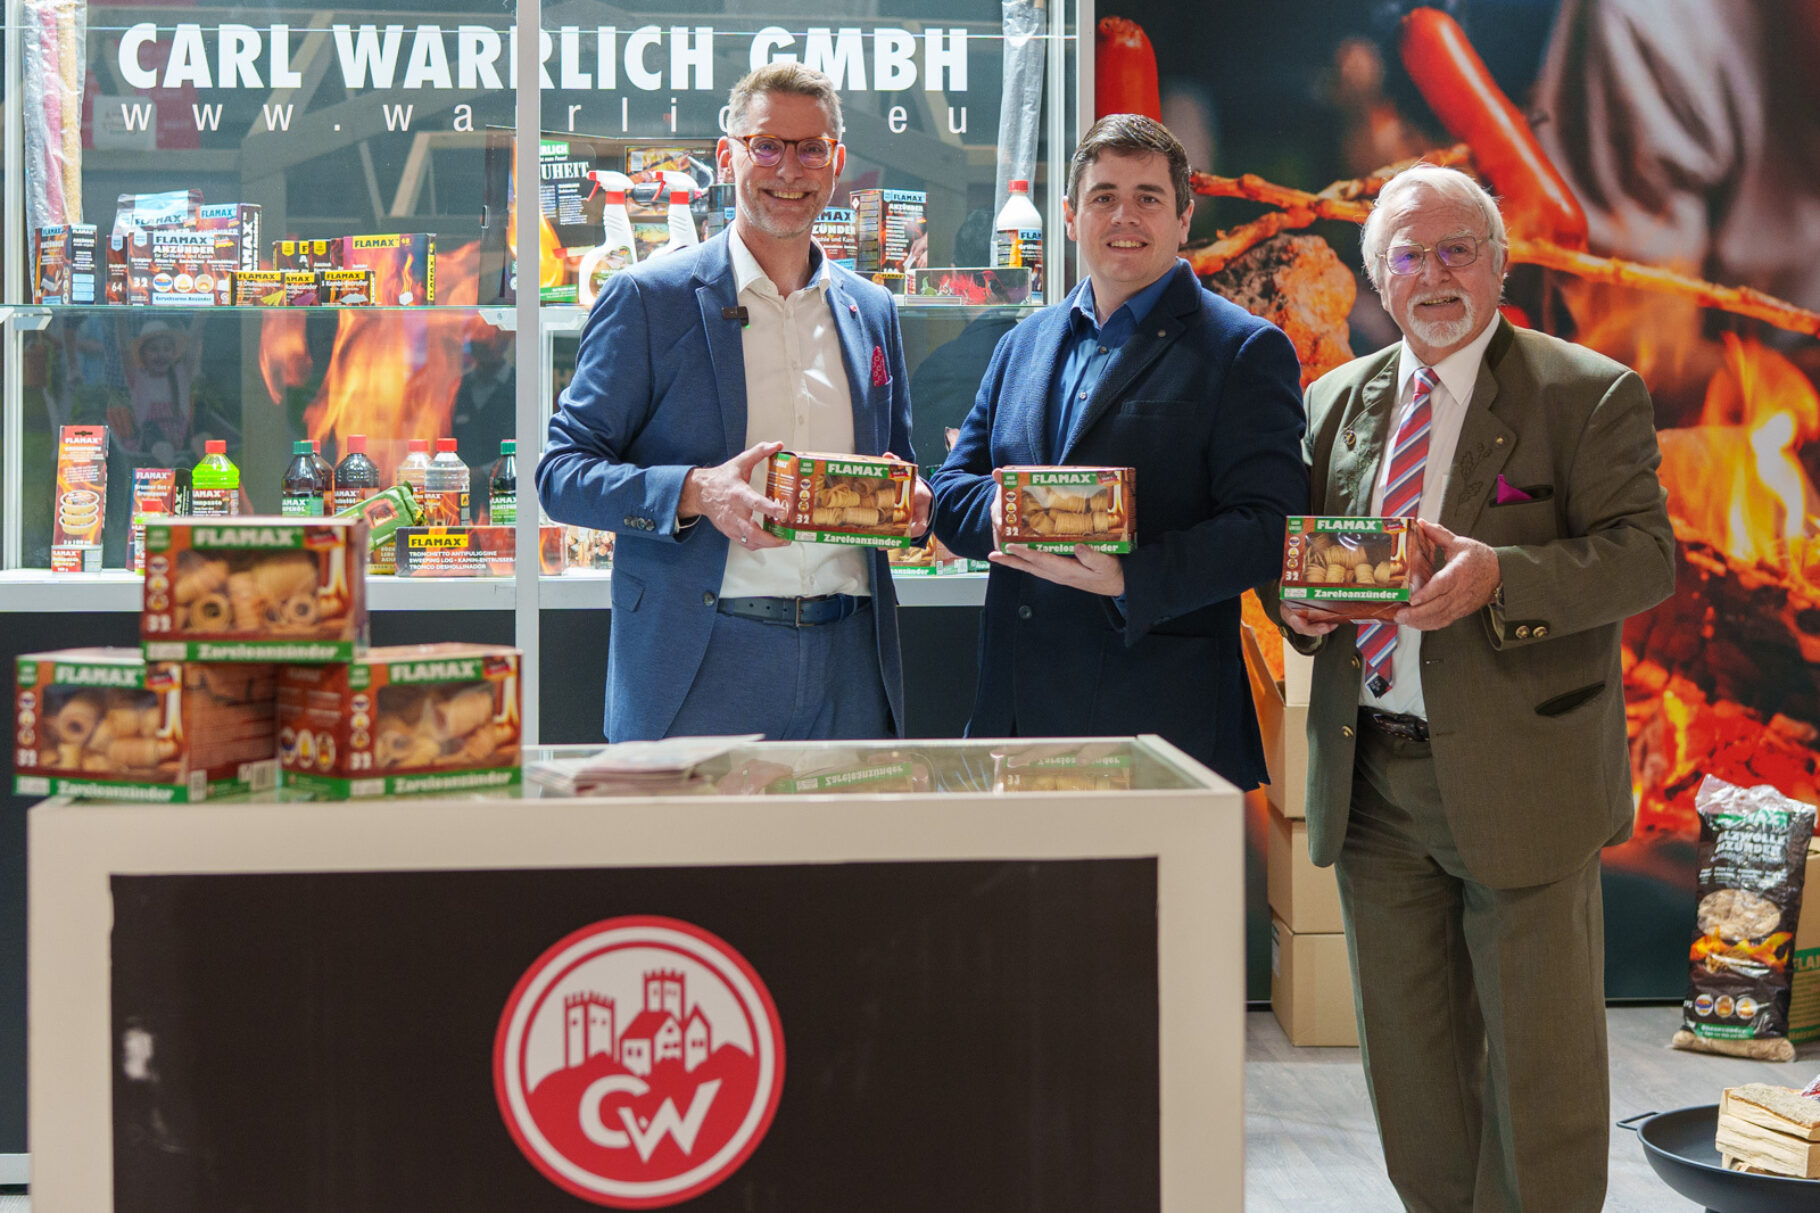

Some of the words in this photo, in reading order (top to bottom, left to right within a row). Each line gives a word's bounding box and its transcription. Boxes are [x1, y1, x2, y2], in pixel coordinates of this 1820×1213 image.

[118, 23, 302, 90] CARL
[748, 26, 968, 91] GMBH
[201, 209, 233, 218] FLAMAX
[155, 236, 208, 245] FLAMAX
[354, 240, 395, 248] FLAMAX
[239, 272, 276, 280] FLAMAX
[326, 272, 360, 280] FLAMAX
[111, 282, 123, 293] 64
[133, 277, 148, 288] 32
[65, 437, 98, 445] FLAMAX
[828, 463, 883, 477] FLAMAX
[1032, 473, 1091, 484] FLAMAX
[796, 513, 810, 525] 32
[1317, 519, 1377, 531] FLAMAX
[193, 528, 294, 546] FLAMAX
[1005, 526, 1020, 537] 32
[411, 538, 461, 546] FLAMAX
[1285, 570, 1299, 582] 32
[55, 666, 138, 687] FLAMAX
[390, 662, 477, 682] FLAMAX
[578, 1073, 722, 1164] CW
